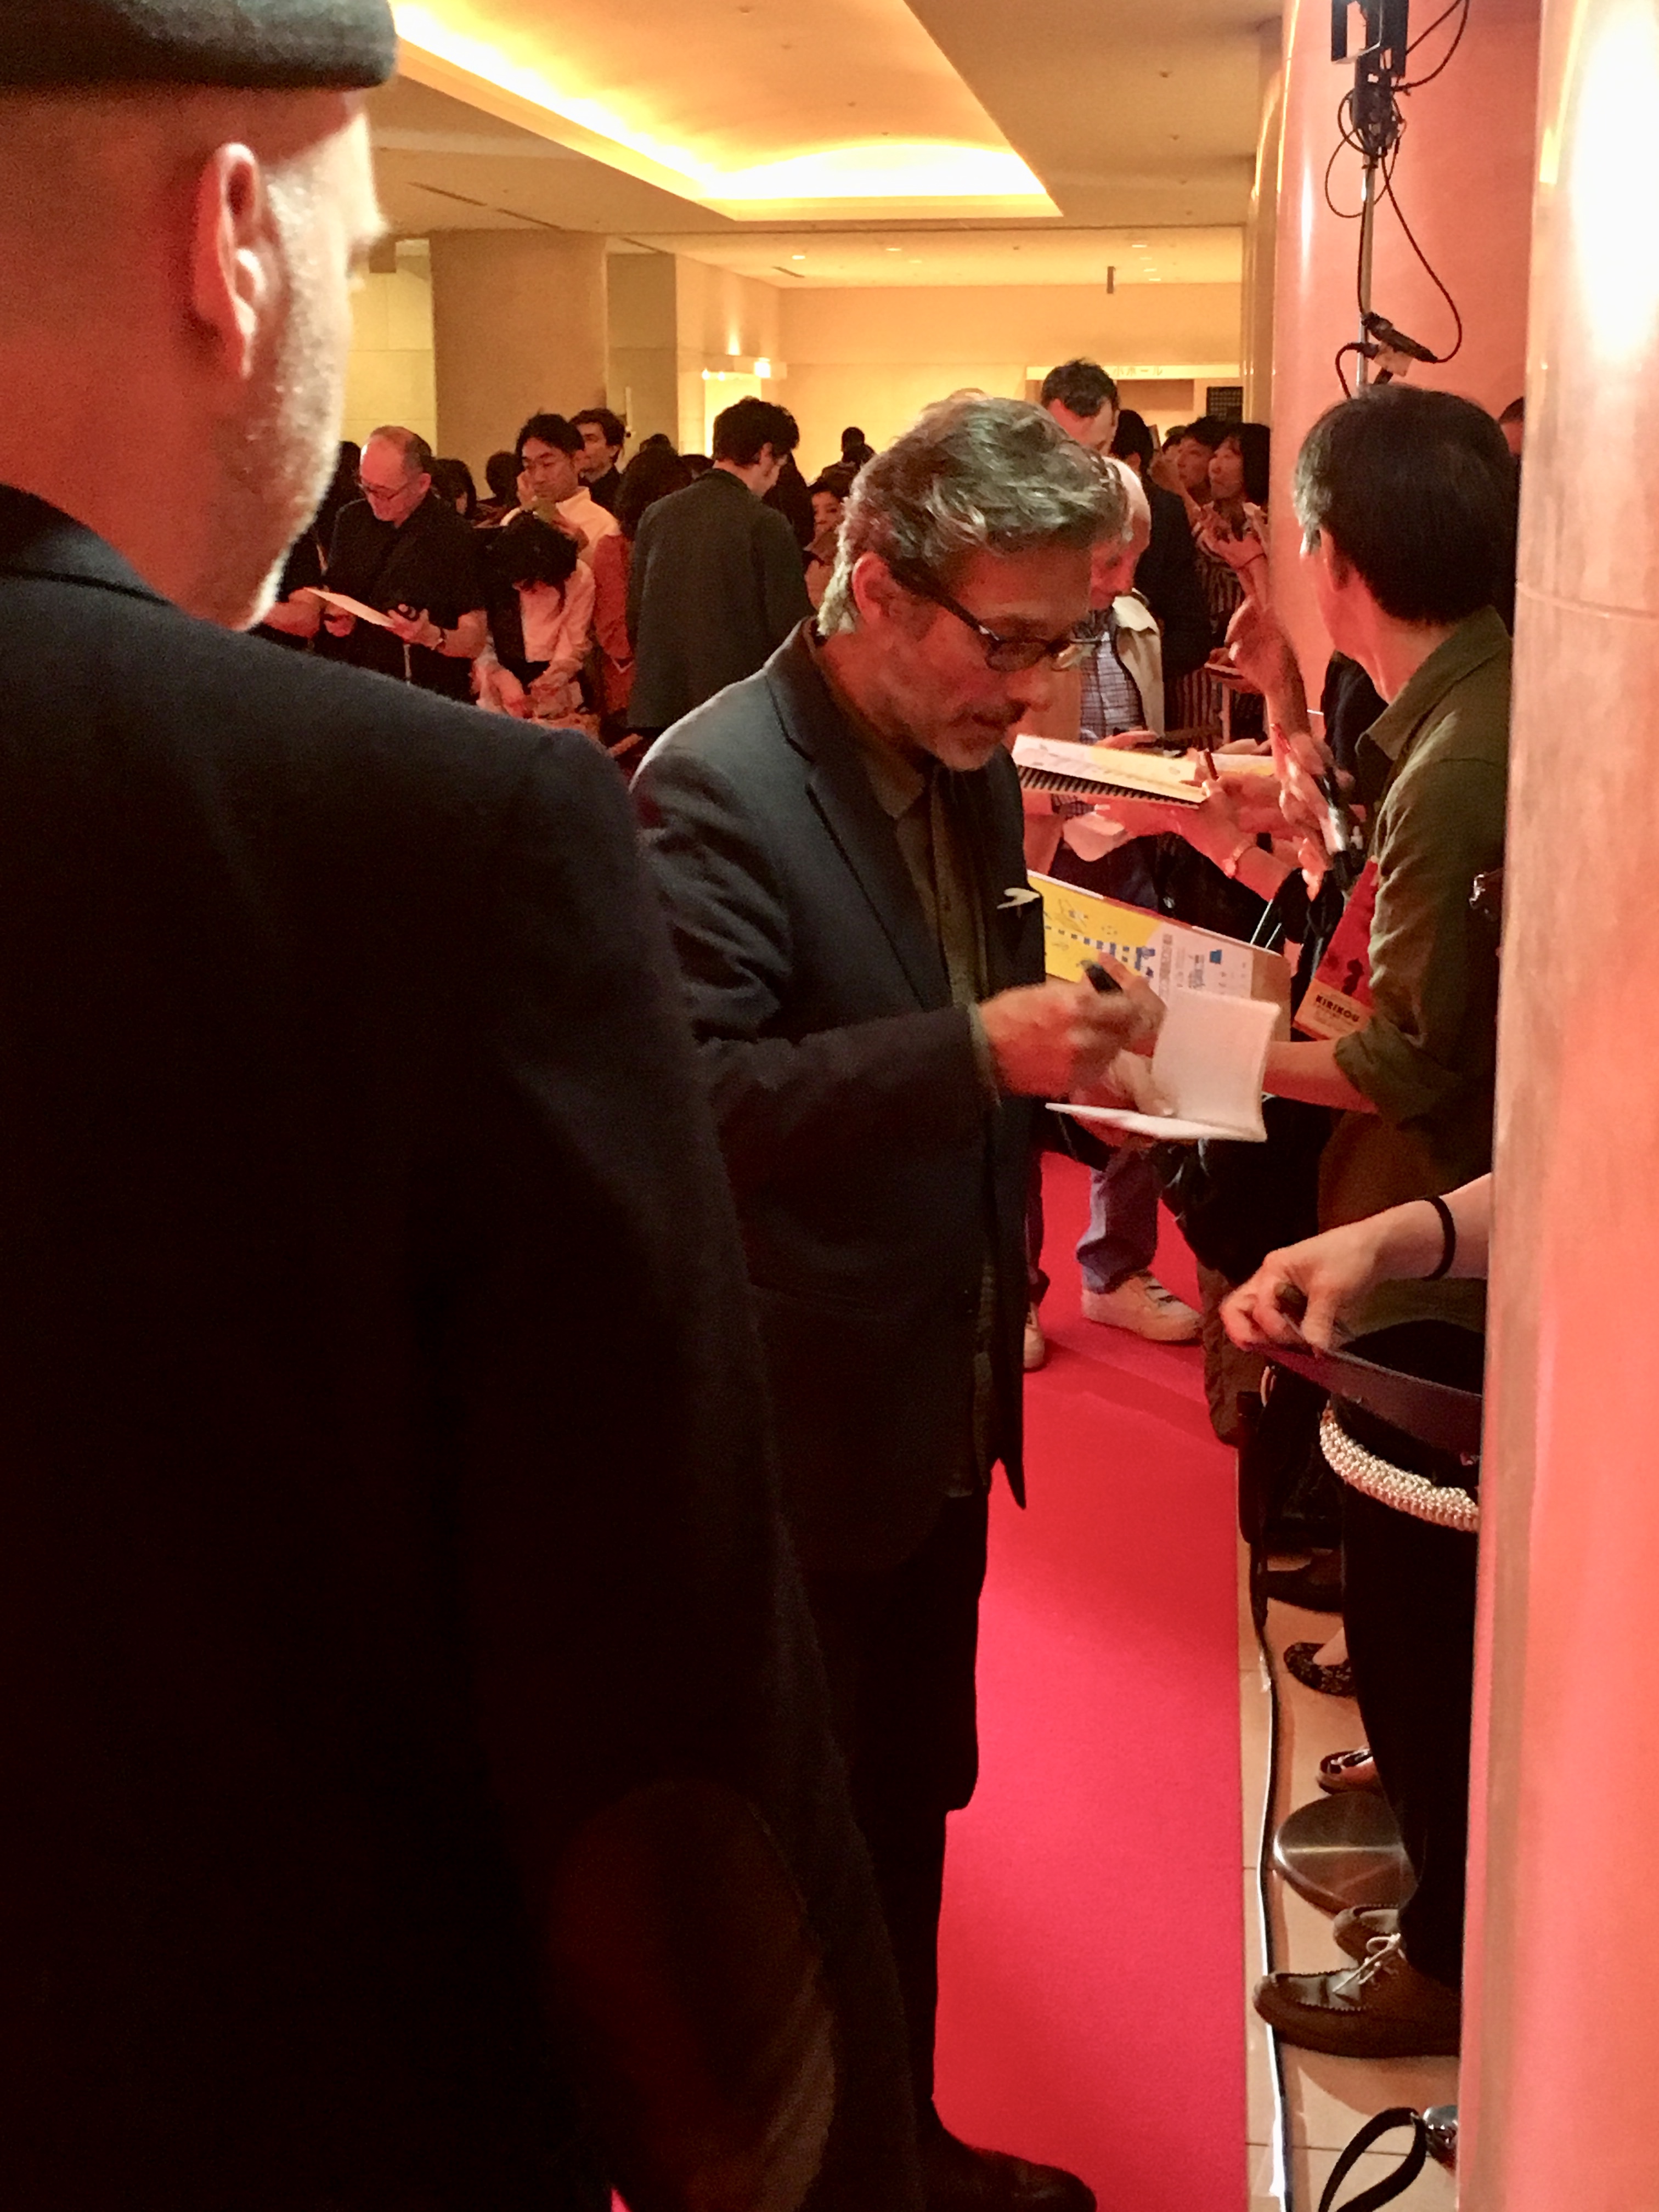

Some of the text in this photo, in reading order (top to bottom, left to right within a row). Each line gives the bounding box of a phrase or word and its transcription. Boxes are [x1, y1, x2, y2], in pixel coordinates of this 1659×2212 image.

[1113, 366, 1163, 376] 小ホール
[1316, 995, 1359, 1022] KIRIKOU
